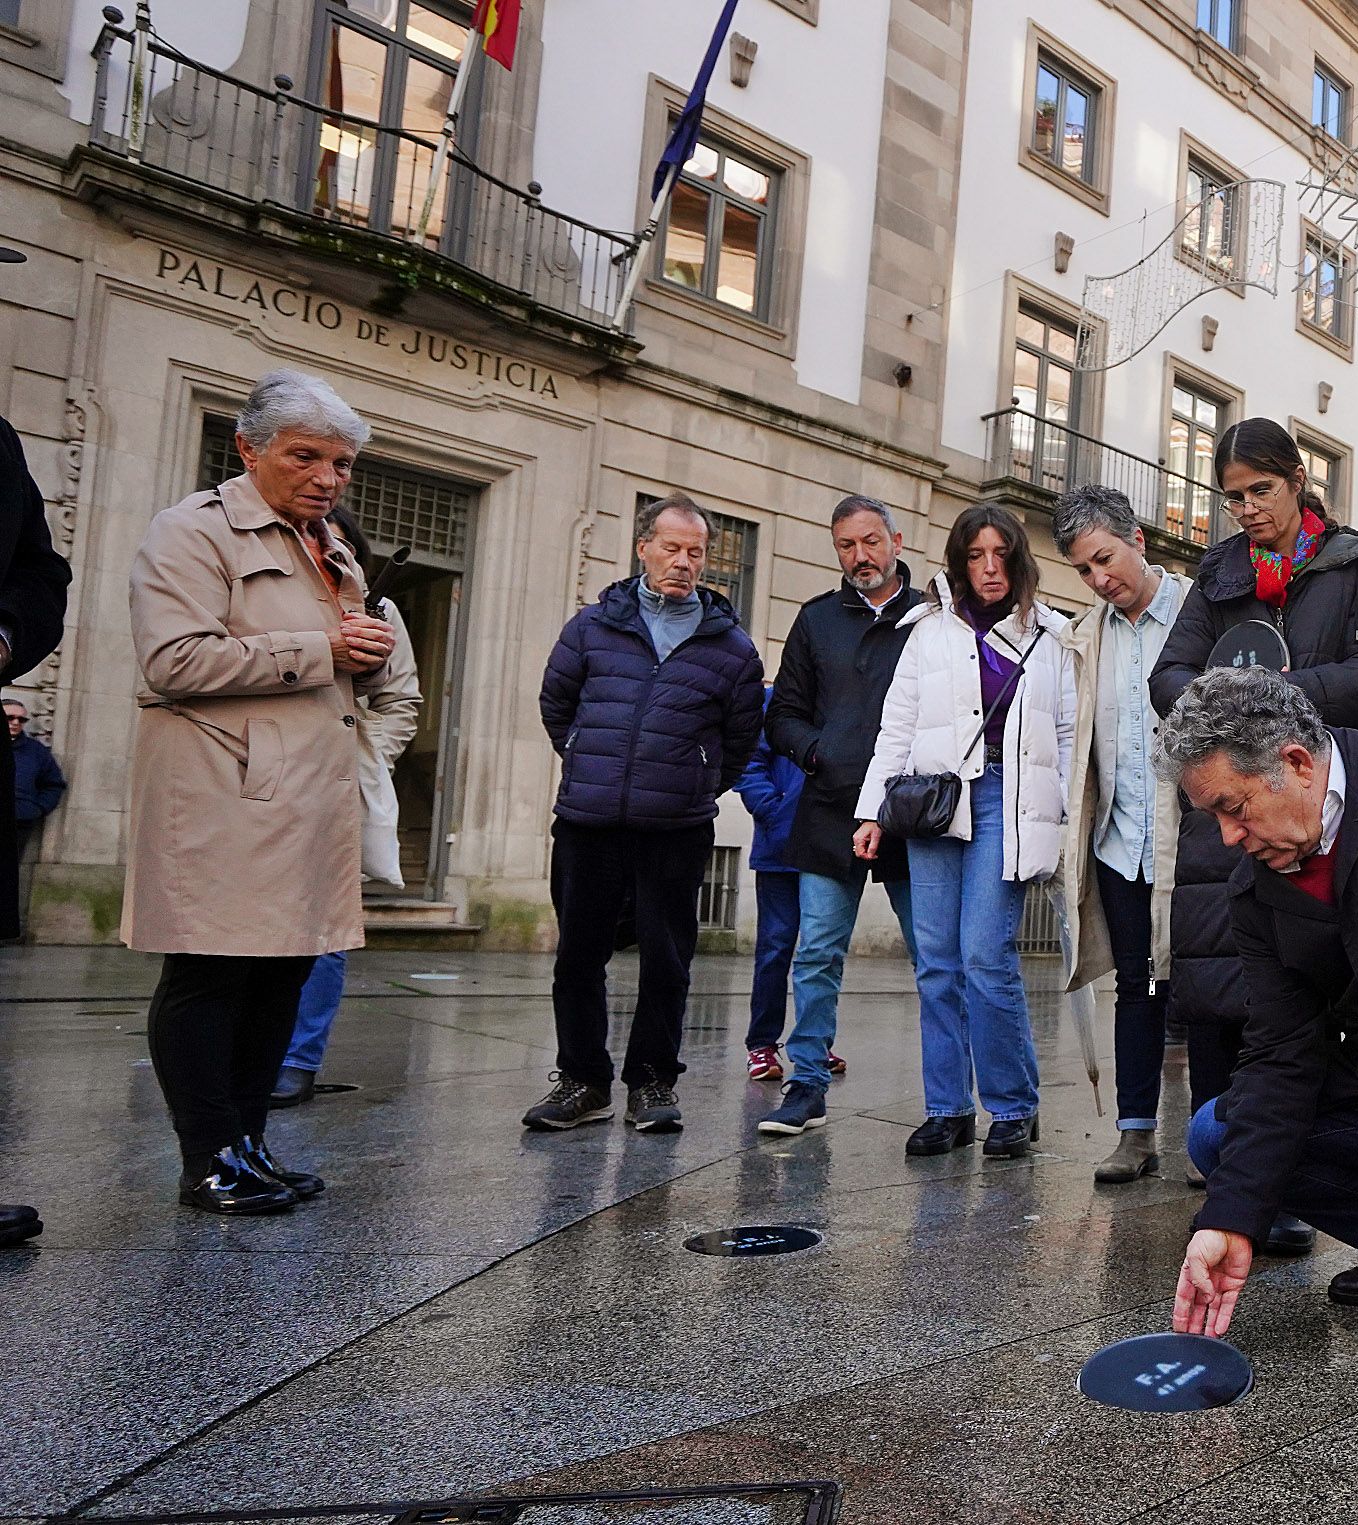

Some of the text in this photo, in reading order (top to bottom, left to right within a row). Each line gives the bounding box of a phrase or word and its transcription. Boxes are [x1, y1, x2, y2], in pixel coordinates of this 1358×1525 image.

[155, 248, 559, 399] PALACIO DE JUSTICIA
